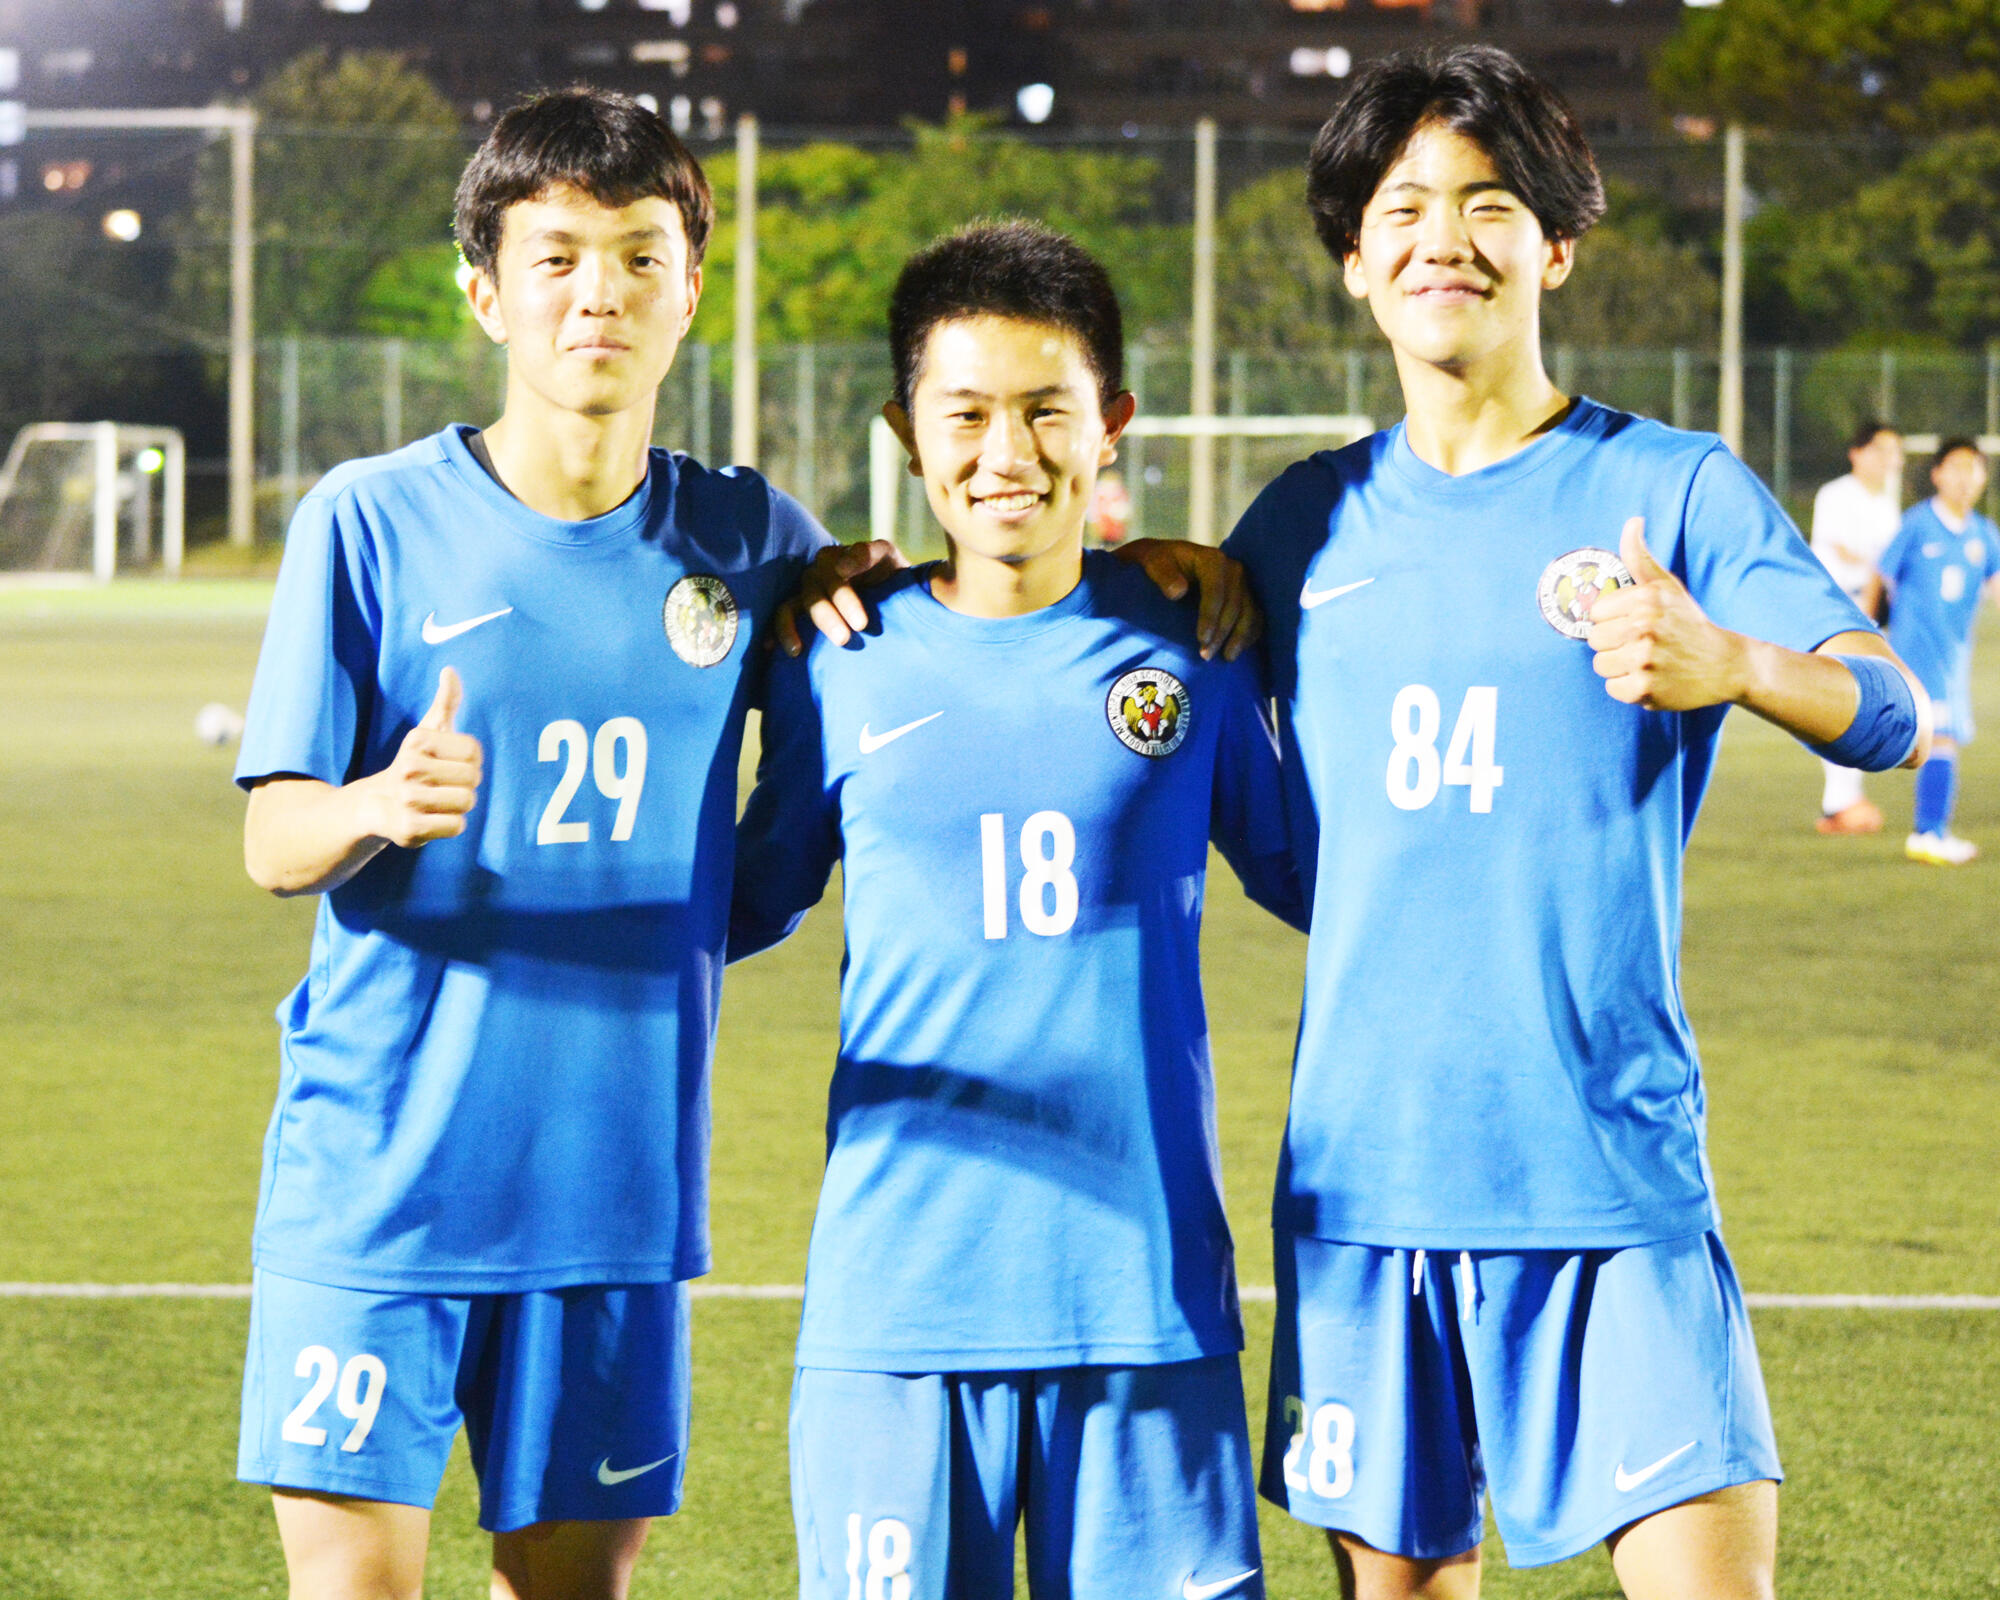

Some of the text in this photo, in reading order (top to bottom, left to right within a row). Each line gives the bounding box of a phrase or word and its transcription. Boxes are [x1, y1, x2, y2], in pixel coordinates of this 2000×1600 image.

[537, 716, 648, 845] 29
[1386, 684, 1504, 814] 84
[980, 810, 1079, 940] 18
[281, 1345, 388, 1453] 29
[1283, 1395, 1355, 1499] 28
[846, 1513, 911, 1600] 18
